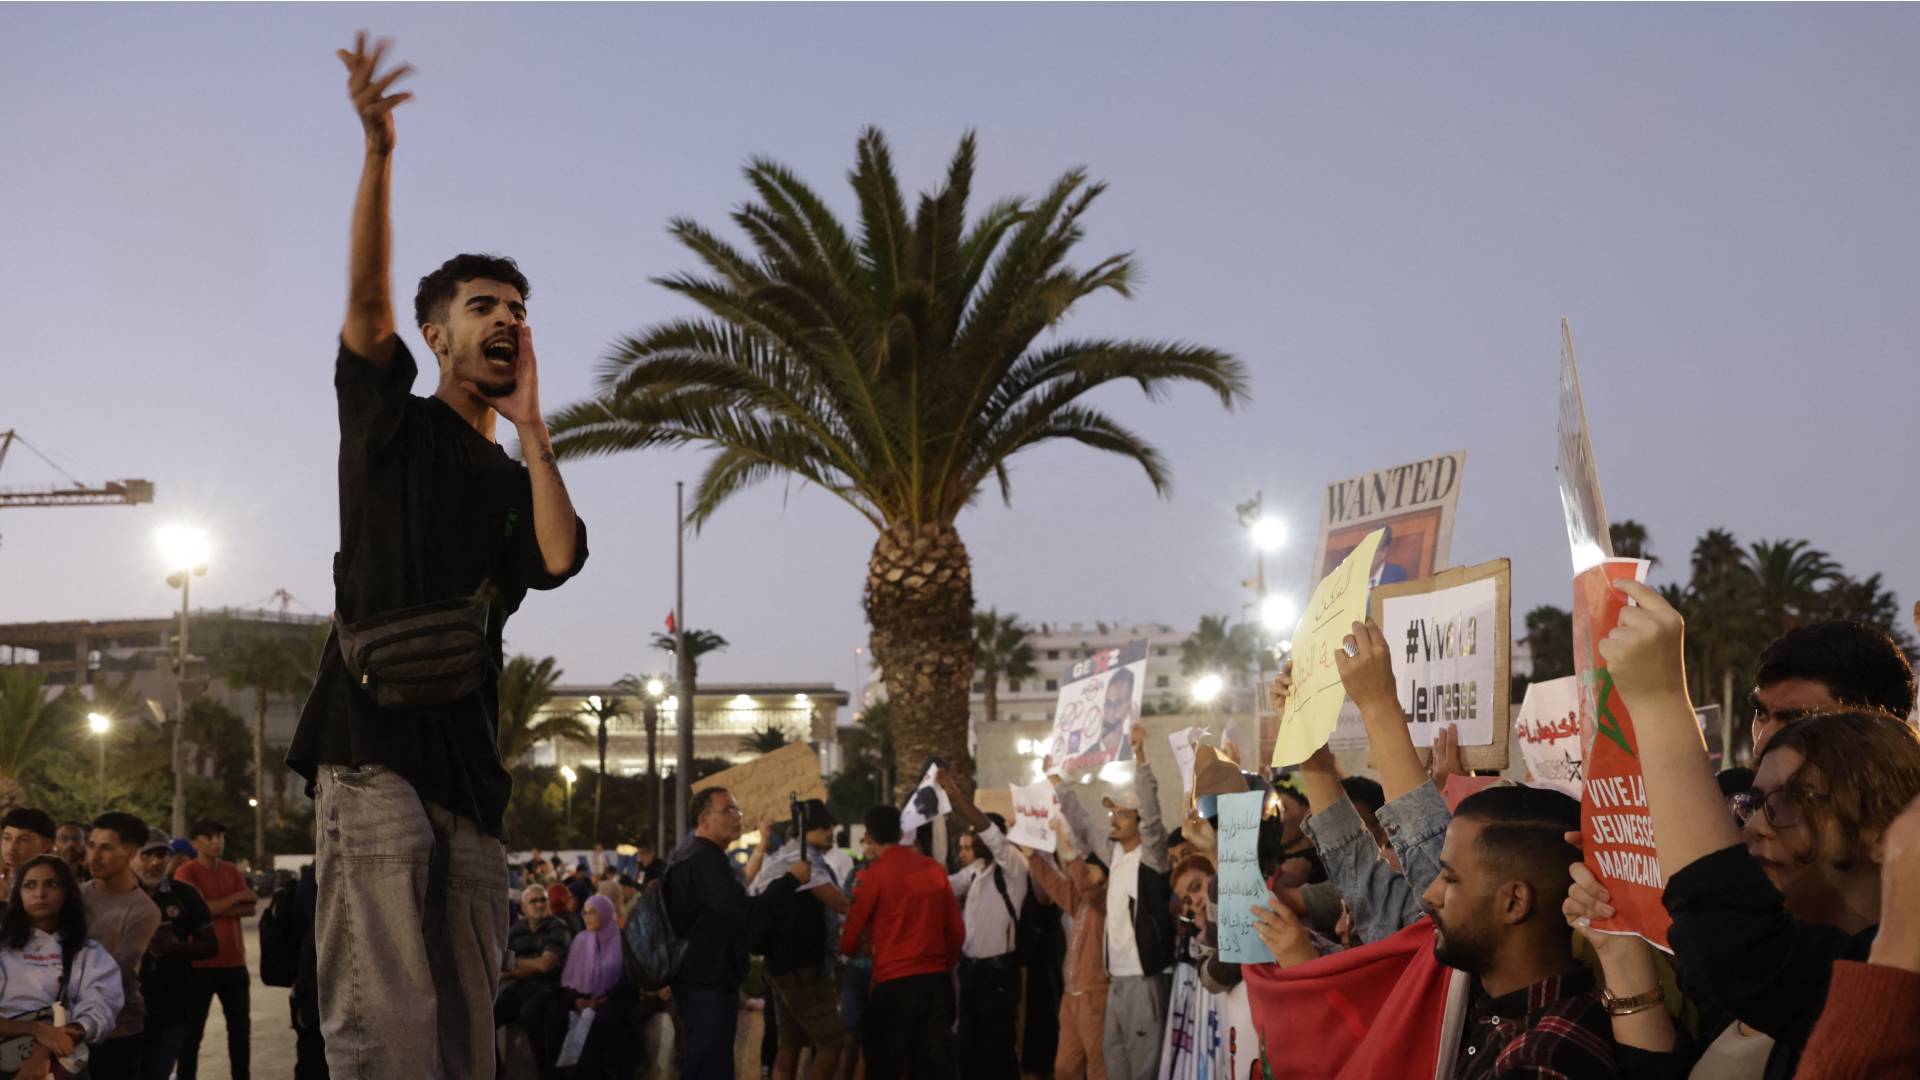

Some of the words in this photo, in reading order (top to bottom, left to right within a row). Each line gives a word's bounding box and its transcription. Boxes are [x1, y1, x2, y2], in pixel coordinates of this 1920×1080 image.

[1328, 455, 1457, 524] WANTED
[1405, 680, 1477, 723] Jeunesse
[1587, 776, 1631, 808] VIVE
[1628, 775, 1648, 807] LA
[1591, 815, 1656, 849] JEUNESSE
[1594, 850, 1664, 889] MAROCAIN
